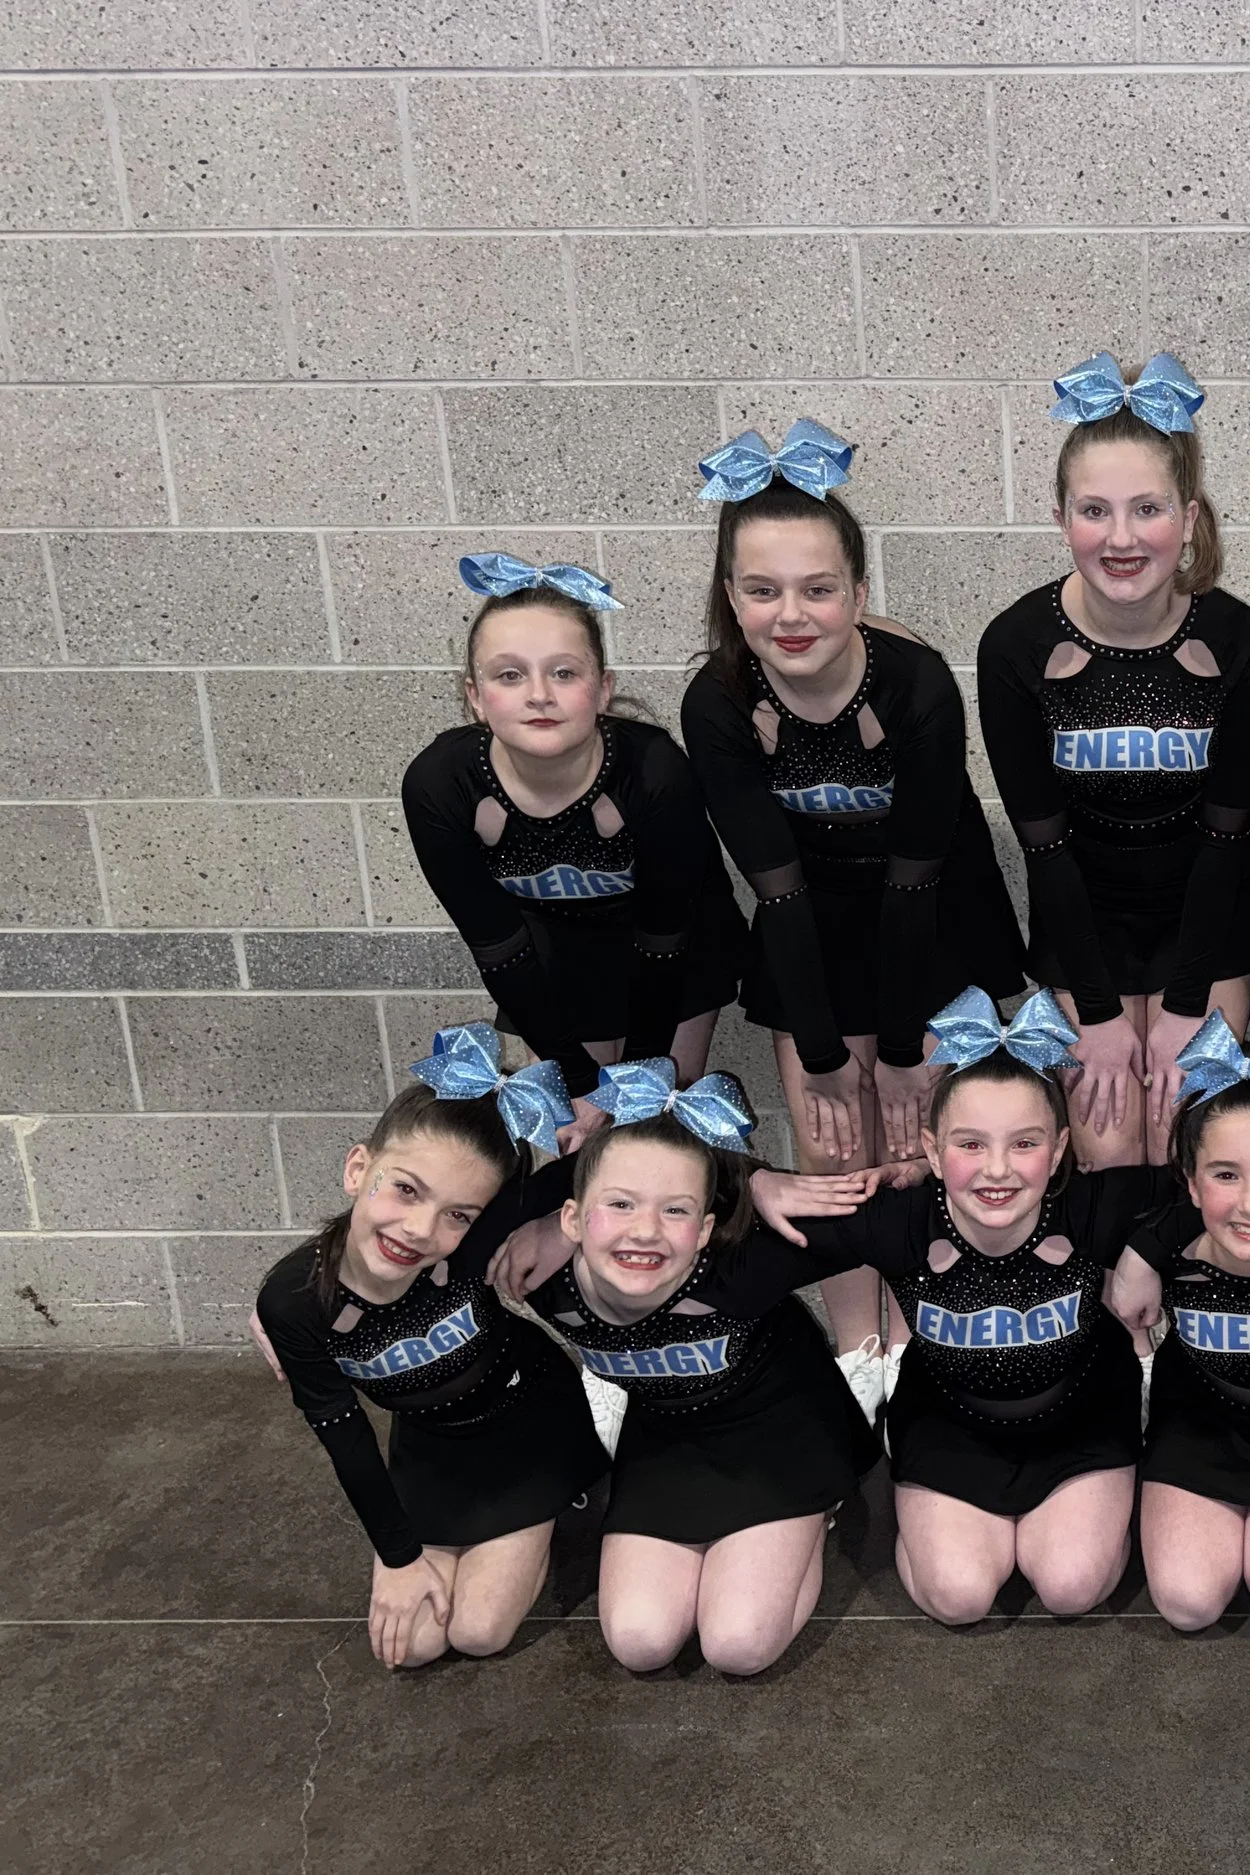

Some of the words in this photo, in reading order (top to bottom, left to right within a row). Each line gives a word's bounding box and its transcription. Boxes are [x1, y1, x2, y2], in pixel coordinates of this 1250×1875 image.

[1054, 729, 1212, 769] ENERGY
[501, 865, 634, 898] NERG
[918, 1295, 1078, 1347] ENERGY
[339, 1307, 477, 1378] ENERGY
[579, 1338, 725, 1375] NERGY
